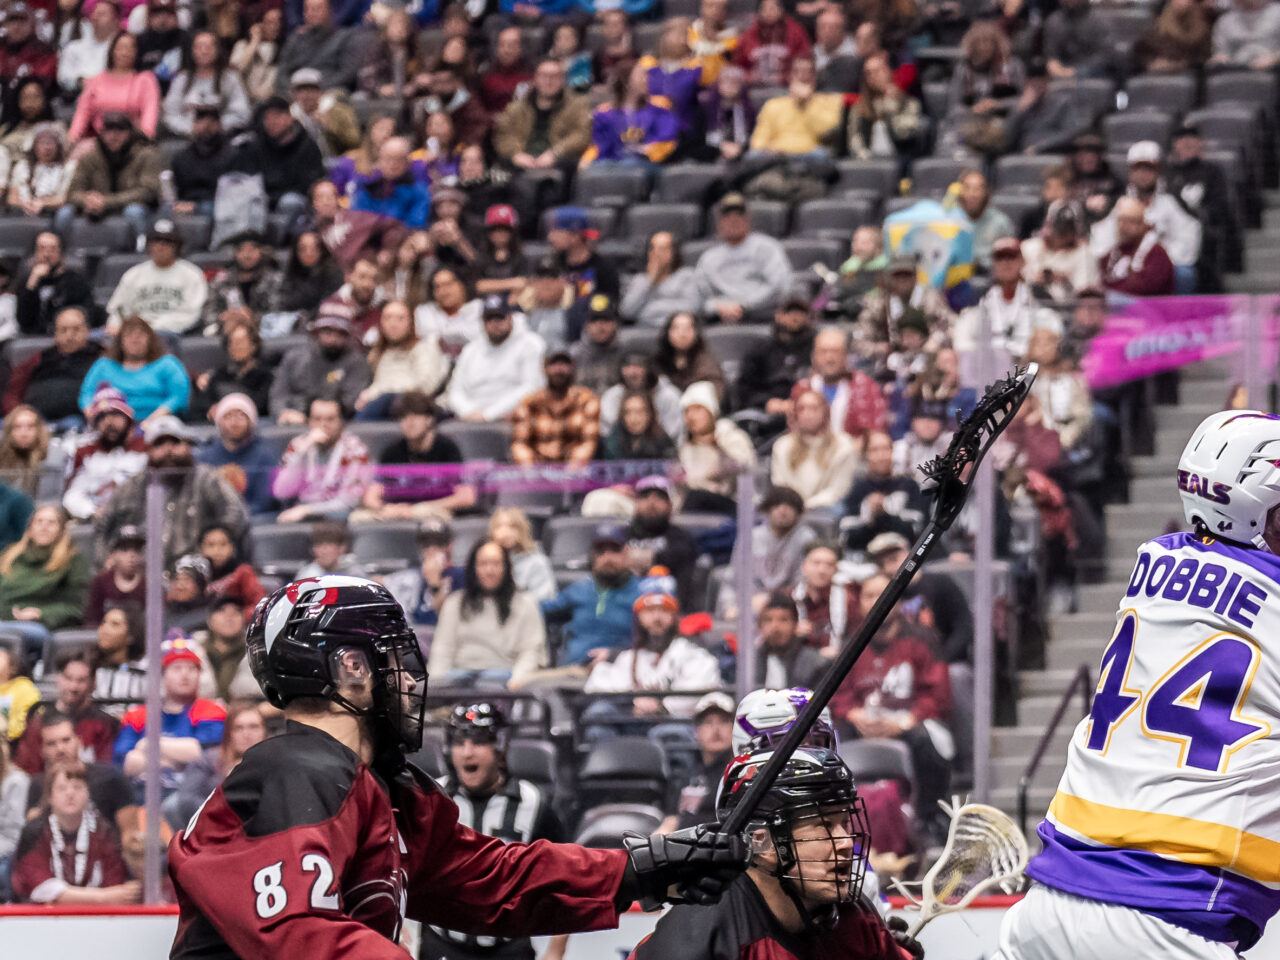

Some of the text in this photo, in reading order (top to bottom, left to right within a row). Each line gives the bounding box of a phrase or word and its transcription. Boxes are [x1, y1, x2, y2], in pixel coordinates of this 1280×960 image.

[1126, 552, 1268, 629] DOBBIE
[1085, 608, 1271, 774] 44
[253, 853, 340, 919] 82
